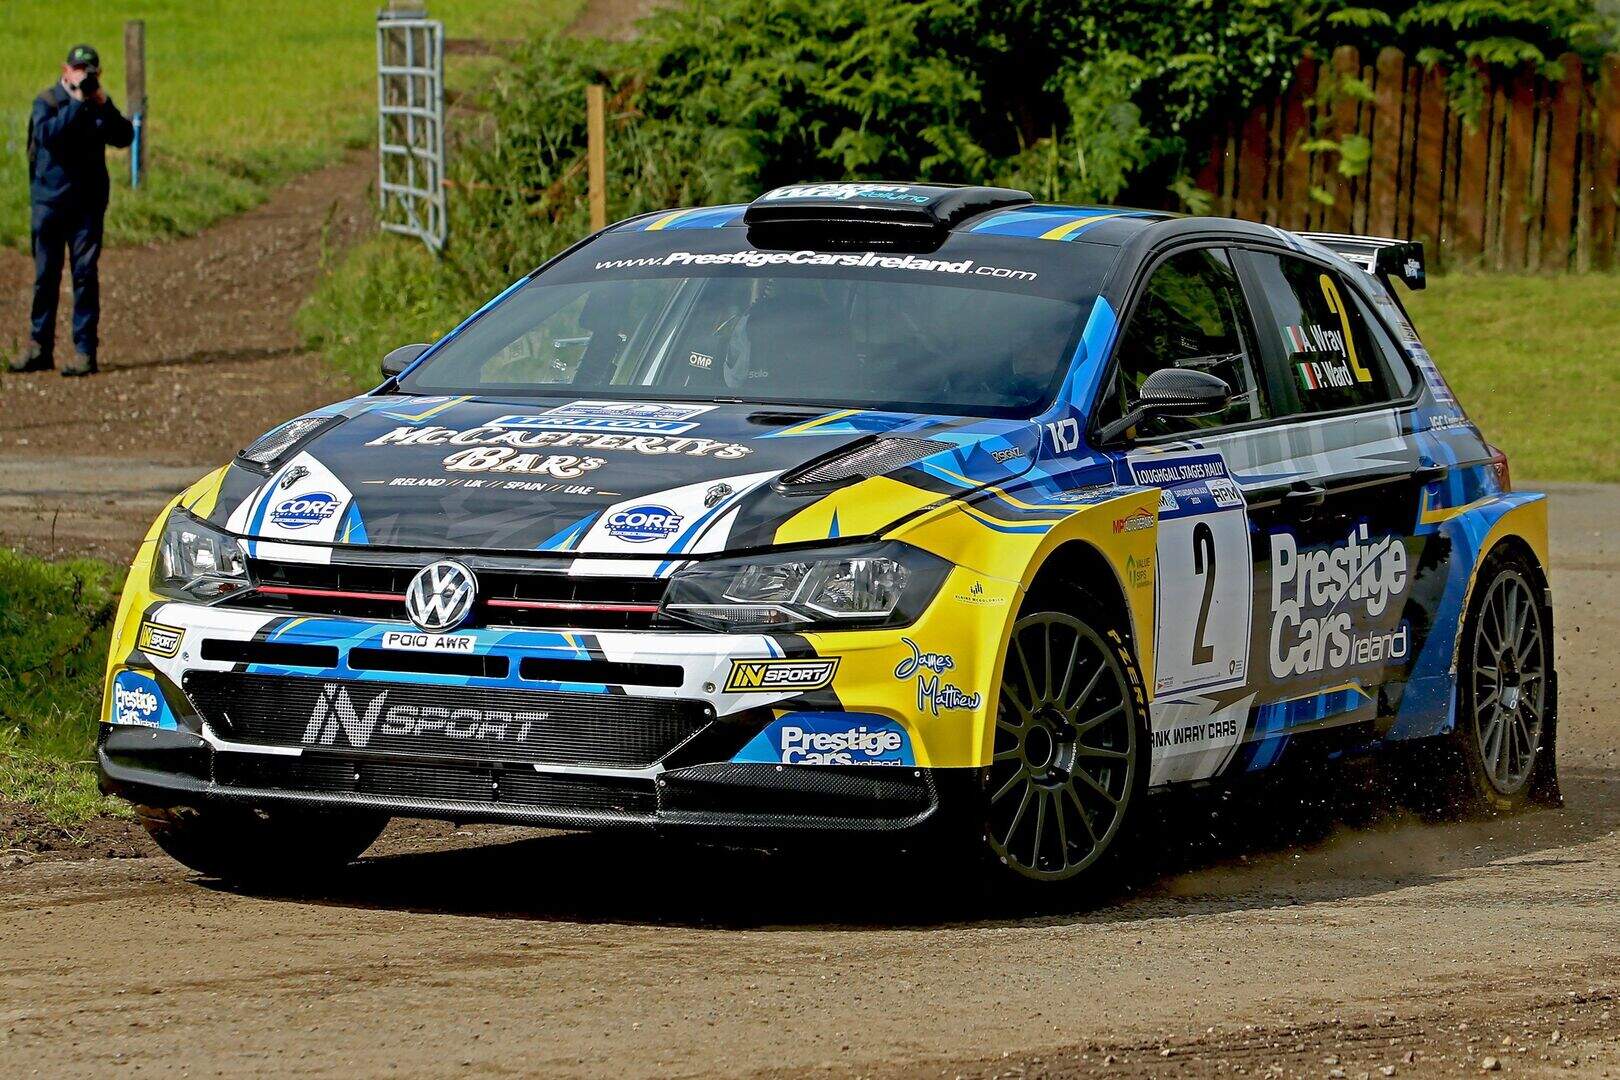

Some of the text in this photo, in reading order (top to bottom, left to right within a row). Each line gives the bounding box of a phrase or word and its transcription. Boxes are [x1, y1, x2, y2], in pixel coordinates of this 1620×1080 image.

[595, 250, 1038, 281] www.PrestigeCarsIreland.com
[1319, 274, 1373, 382] 2
[689, 354, 712, 368] OMP
[518, 417, 667, 429] TRITON
[1136, 461, 1225, 484] LOUGHGALL STAGES RALLY
[389, 478, 446, 487] IRELAND
[463, 480, 487, 488] UK
[503, 481, 547, 491] SPAIN
[564, 485, 595, 495] UAE
[1211, 487, 1241, 503] RPM
[275, 499, 341, 514] CORE
[608, 512, 684, 529] CORE
[1270, 523, 1407, 616] Prestige
[1192, 522, 1216, 665] 2
[435, 637, 470, 649] AWR
[1270, 600, 1407, 678] Cars Ireland
[895, 637, 954, 678] James
[115, 682, 158, 716] Prestige
[918, 674, 980, 715] Matthew
[781, 726, 901, 756] Prestige
[1173, 724, 1206, 745] WRAY
[1208, 719, 1237, 739] CARS
[781, 746, 852, 765] Cars
